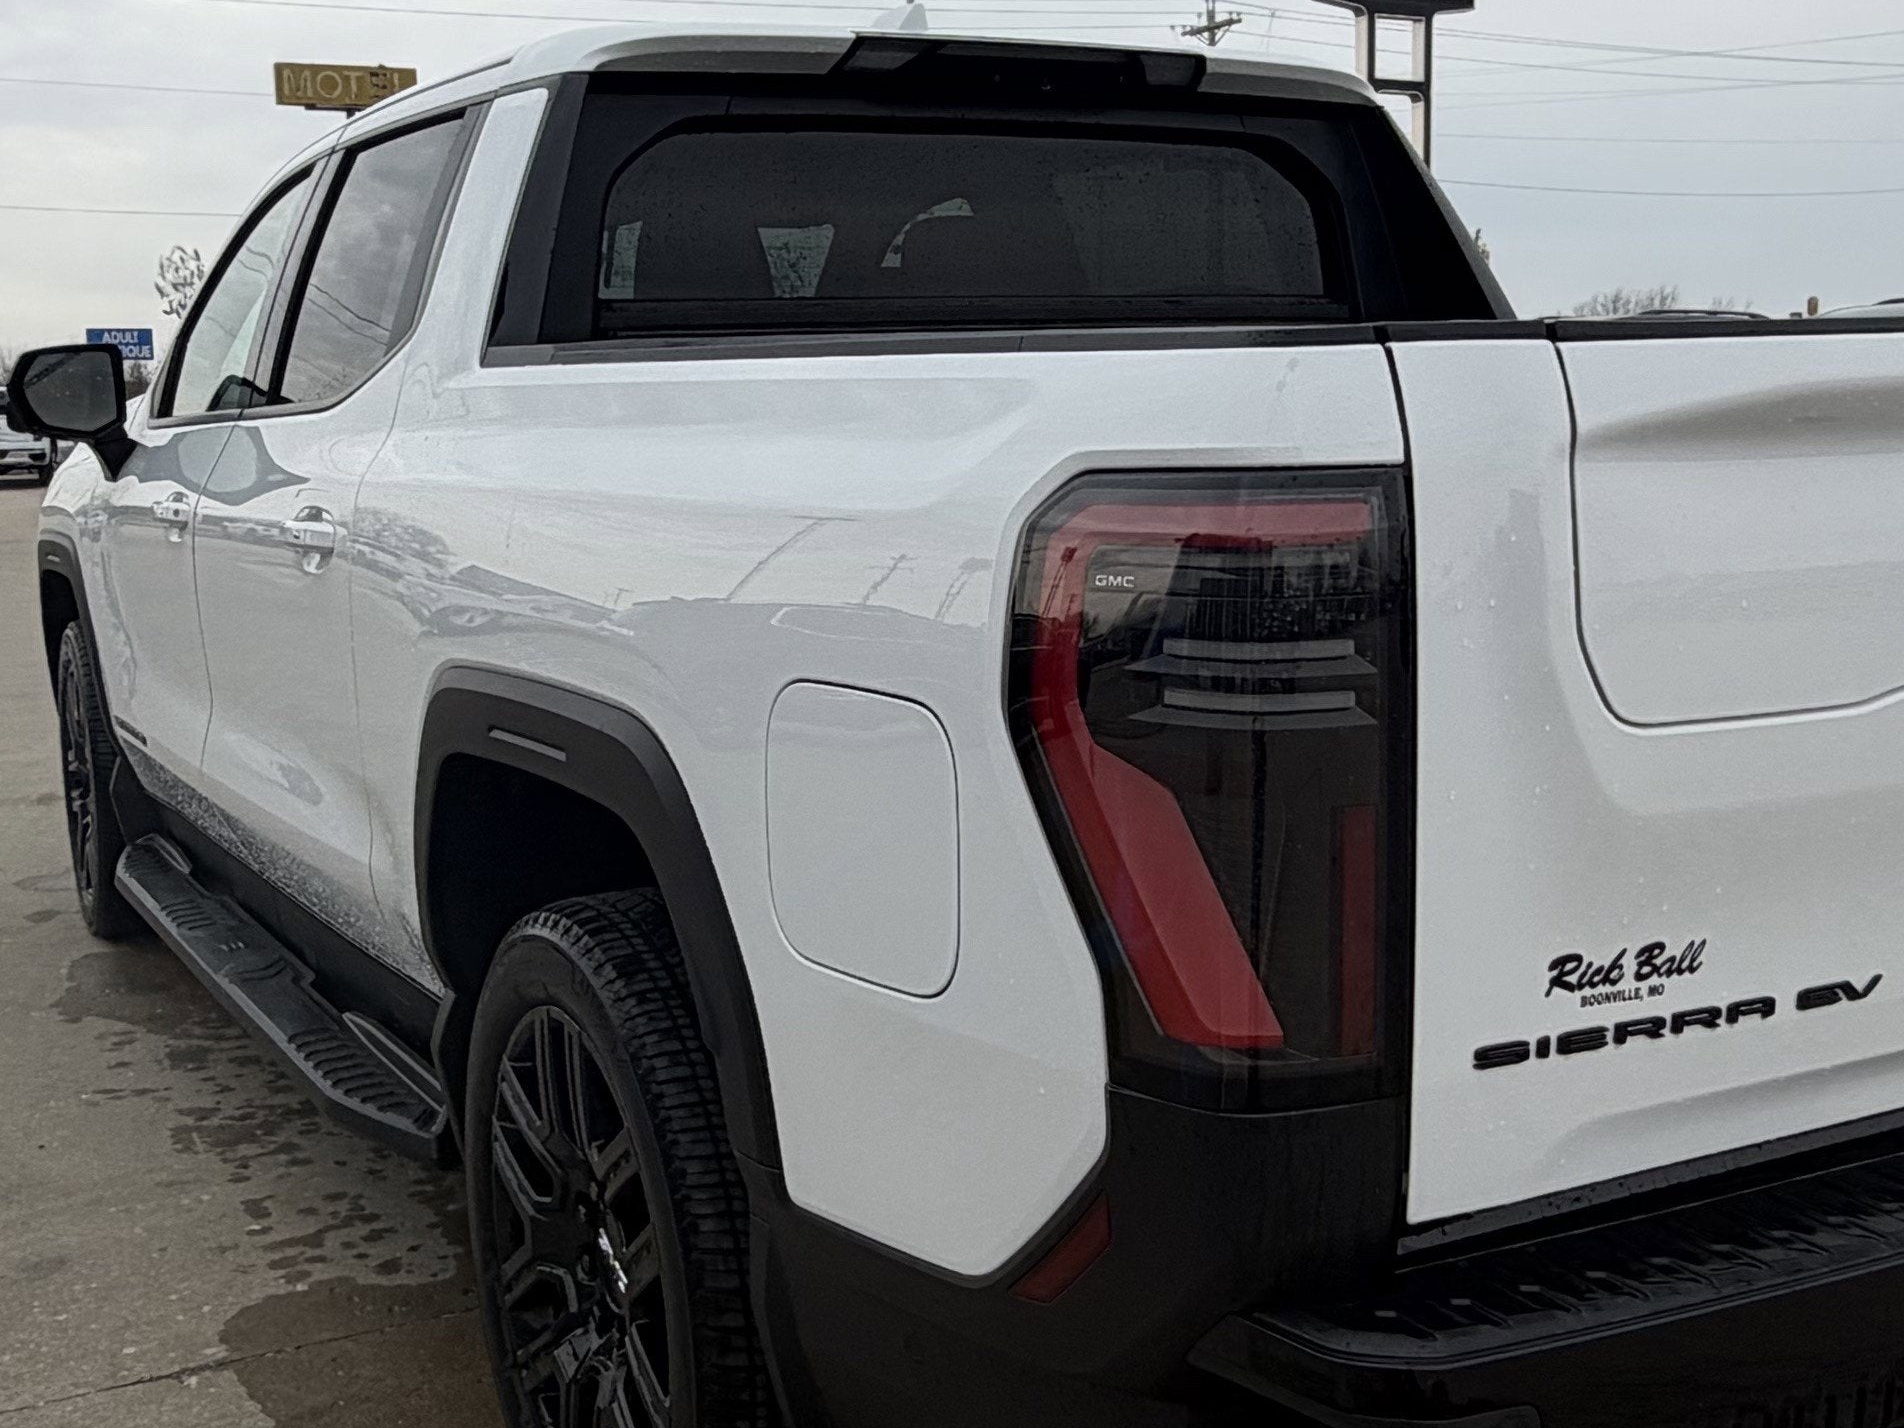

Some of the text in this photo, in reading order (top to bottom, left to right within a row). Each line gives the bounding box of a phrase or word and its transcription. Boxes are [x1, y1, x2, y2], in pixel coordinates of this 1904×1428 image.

[1095, 574, 1135, 588] GMC
[1544, 938, 1707, 998] Rick Ball
[1647, 983, 1666, 998] MO
[1472, 973, 1884, 1071] SIERRA EV
